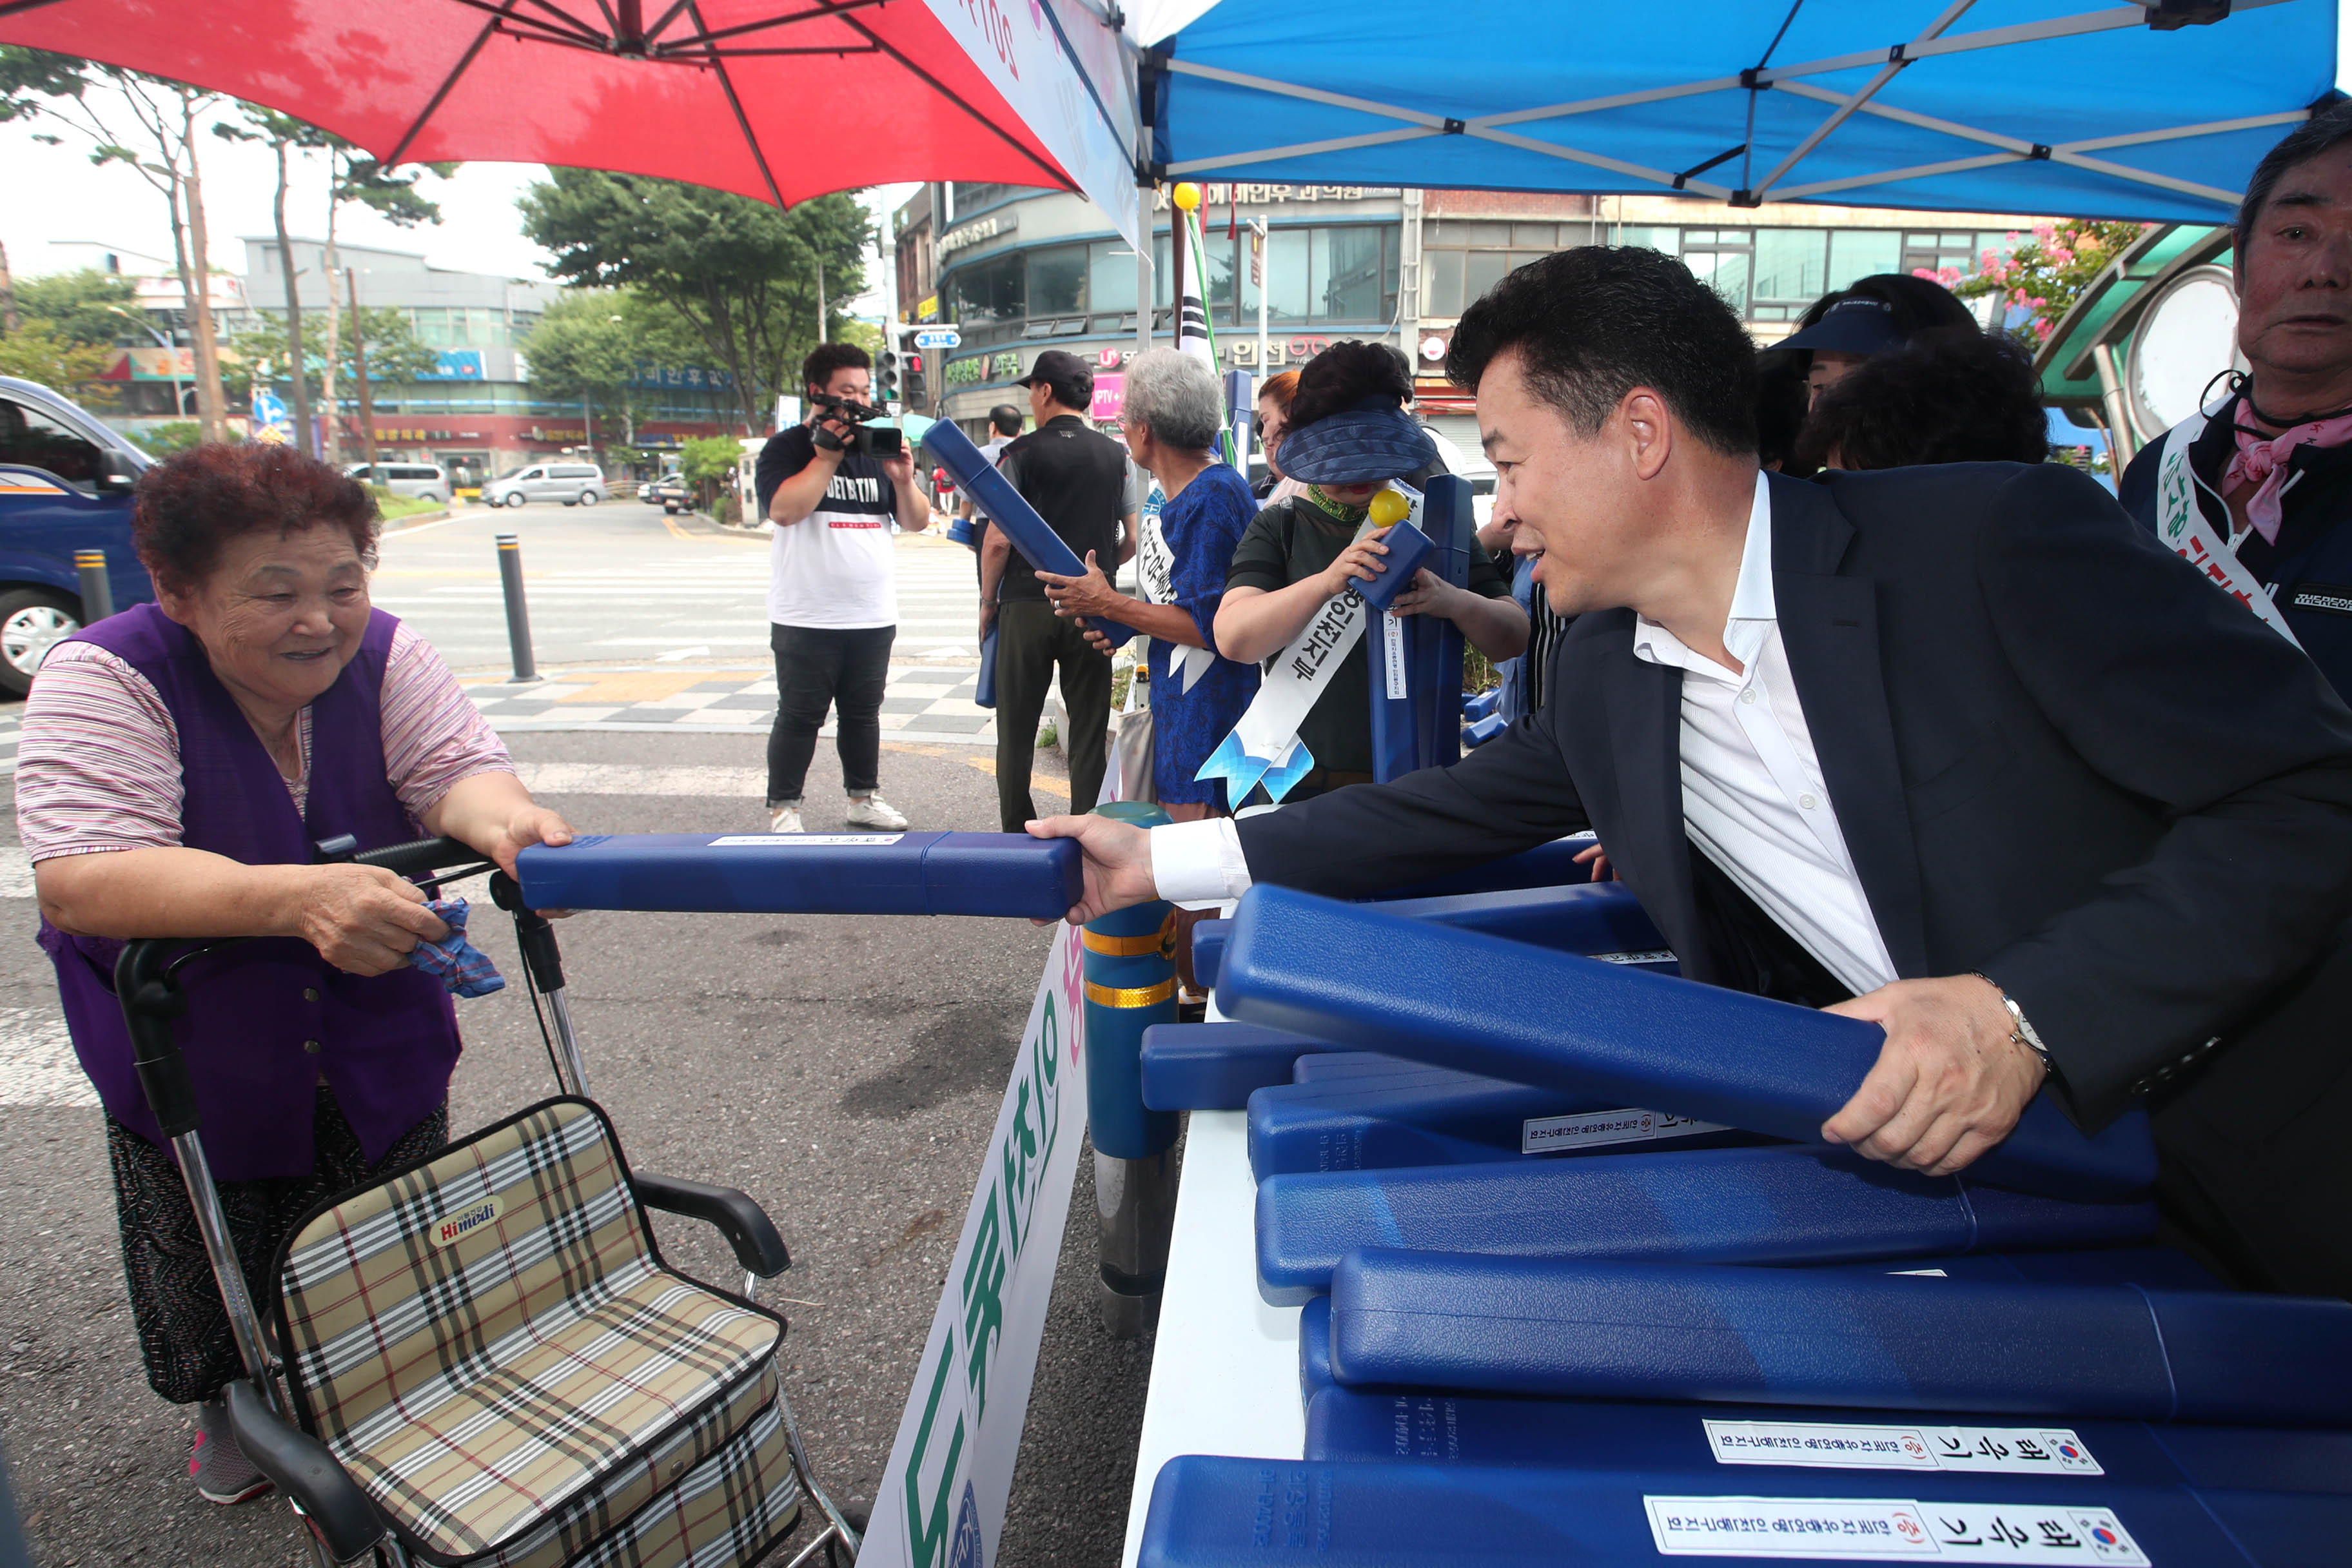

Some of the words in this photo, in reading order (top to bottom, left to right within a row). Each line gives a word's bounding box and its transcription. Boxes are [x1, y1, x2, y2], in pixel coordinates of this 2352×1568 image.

[440, 1203, 495, 1241] Himedi
[1939, 1434, 2051, 1462] 태극기
[1941, 1516, 2082, 1549] 태극기
